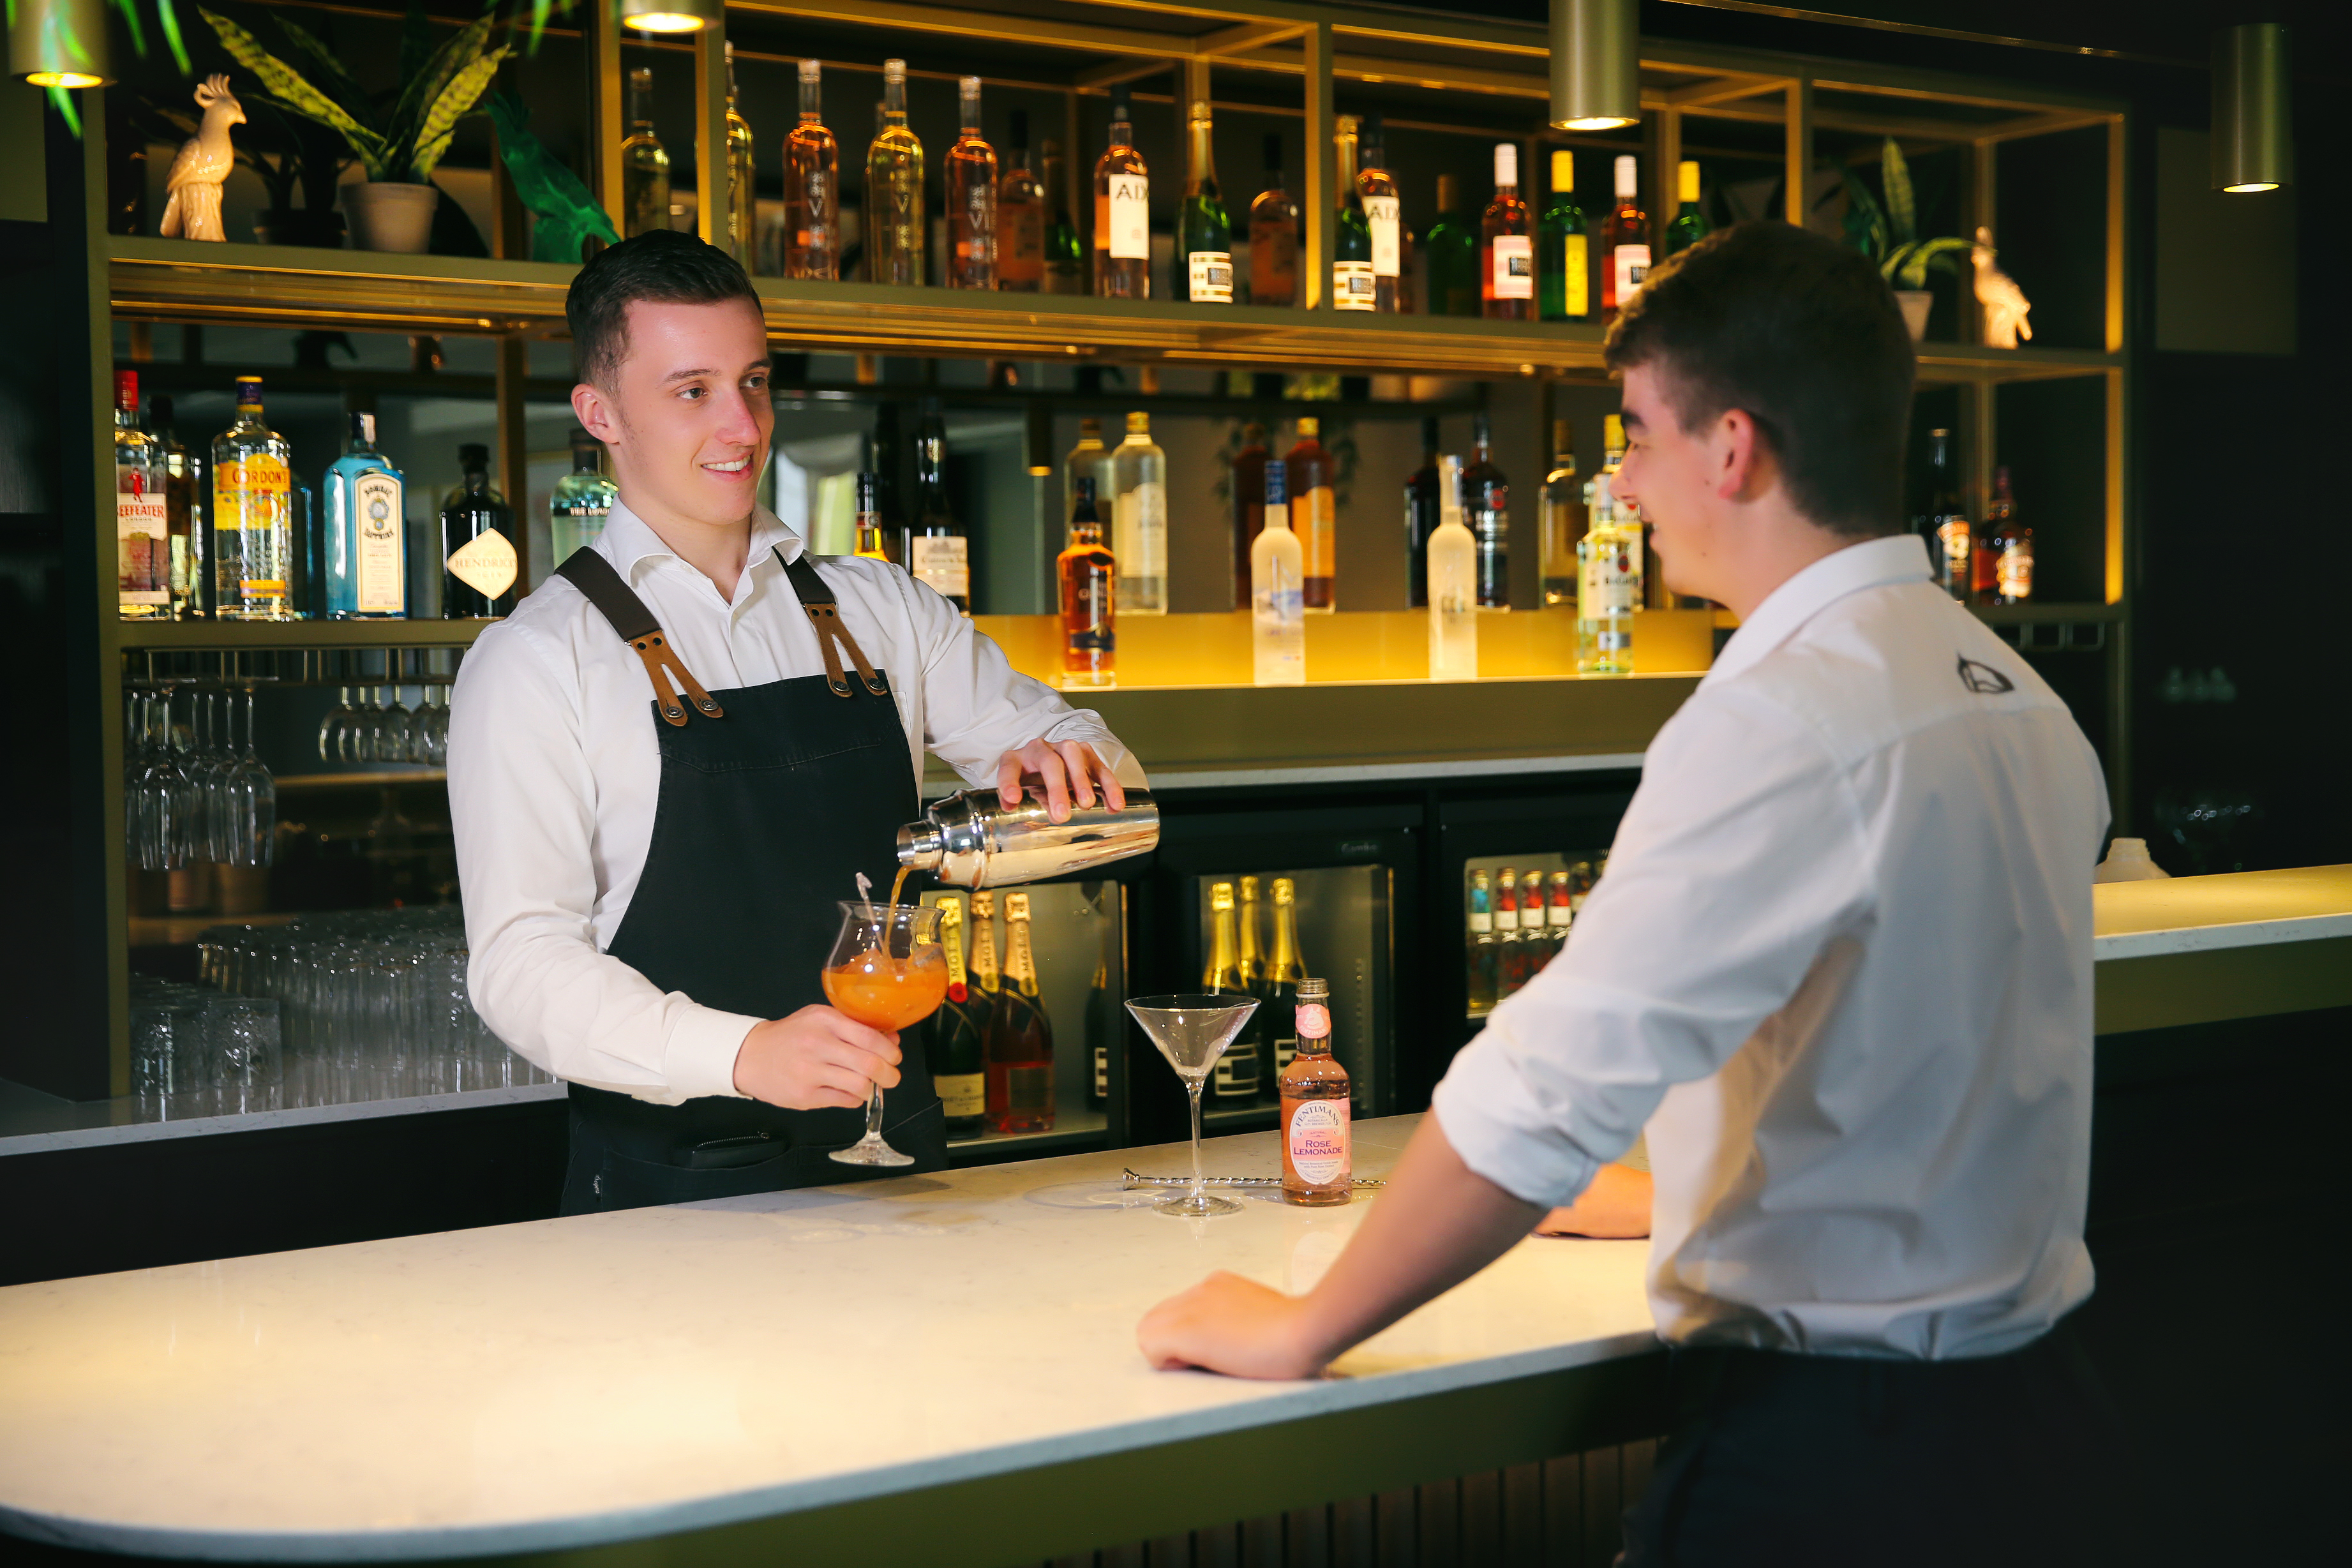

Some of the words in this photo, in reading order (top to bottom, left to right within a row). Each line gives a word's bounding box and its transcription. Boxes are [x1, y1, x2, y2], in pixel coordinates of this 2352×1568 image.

[117, 504, 165, 518] EEFEATER
[1296, 1105, 1340, 1127] FENTIMANS
[1294, 1146, 1342, 1155] LEMONADE
